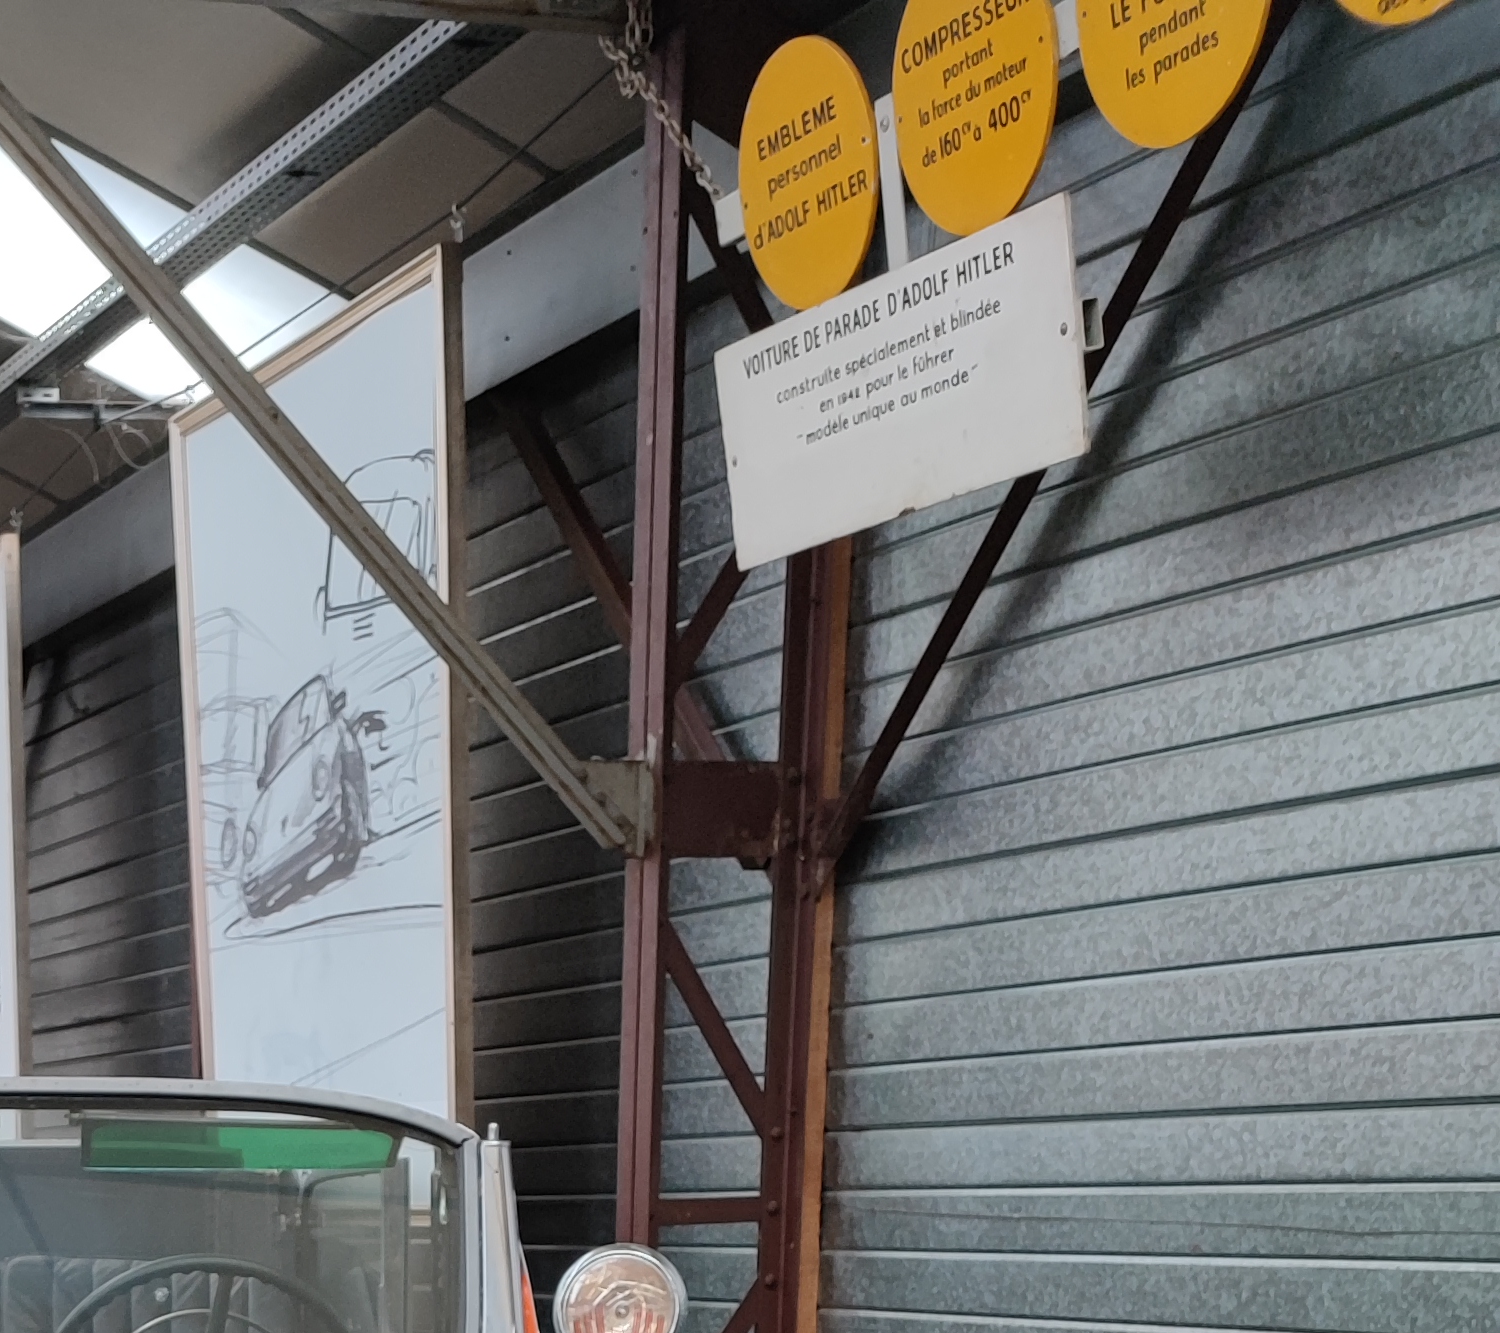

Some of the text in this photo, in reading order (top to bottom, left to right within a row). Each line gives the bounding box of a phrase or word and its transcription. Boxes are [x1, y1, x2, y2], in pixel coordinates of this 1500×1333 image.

[901, 0, 1029, 74] COMPRESSE
[1110, 0, 1131, 30] LE
[1139, 0, 1206, 56] pendant
[942, 38, 994, 89] portant
[1125, 30, 1219, 91] les parades
[918, 57, 1027, 128] la force du moteur
[767, 135, 842, 200] personnel
[922, 146, 937, 168] de
[754, 169, 868, 250] d'ADOLF HITLER
[743, 241, 1015, 379] VOITURE DE PARADE D'ADOLF HITLER
[776, 297, 1001, 404] construite spécialement et blindée
[819, 396, 834, 413] en
[866, 372, 893, 399] pour
[897, 364, 909, 381] le
[852, 399, 896, 422] unique
[900, 390, 917, 407] au
[920, 368, 969, 400] monde
